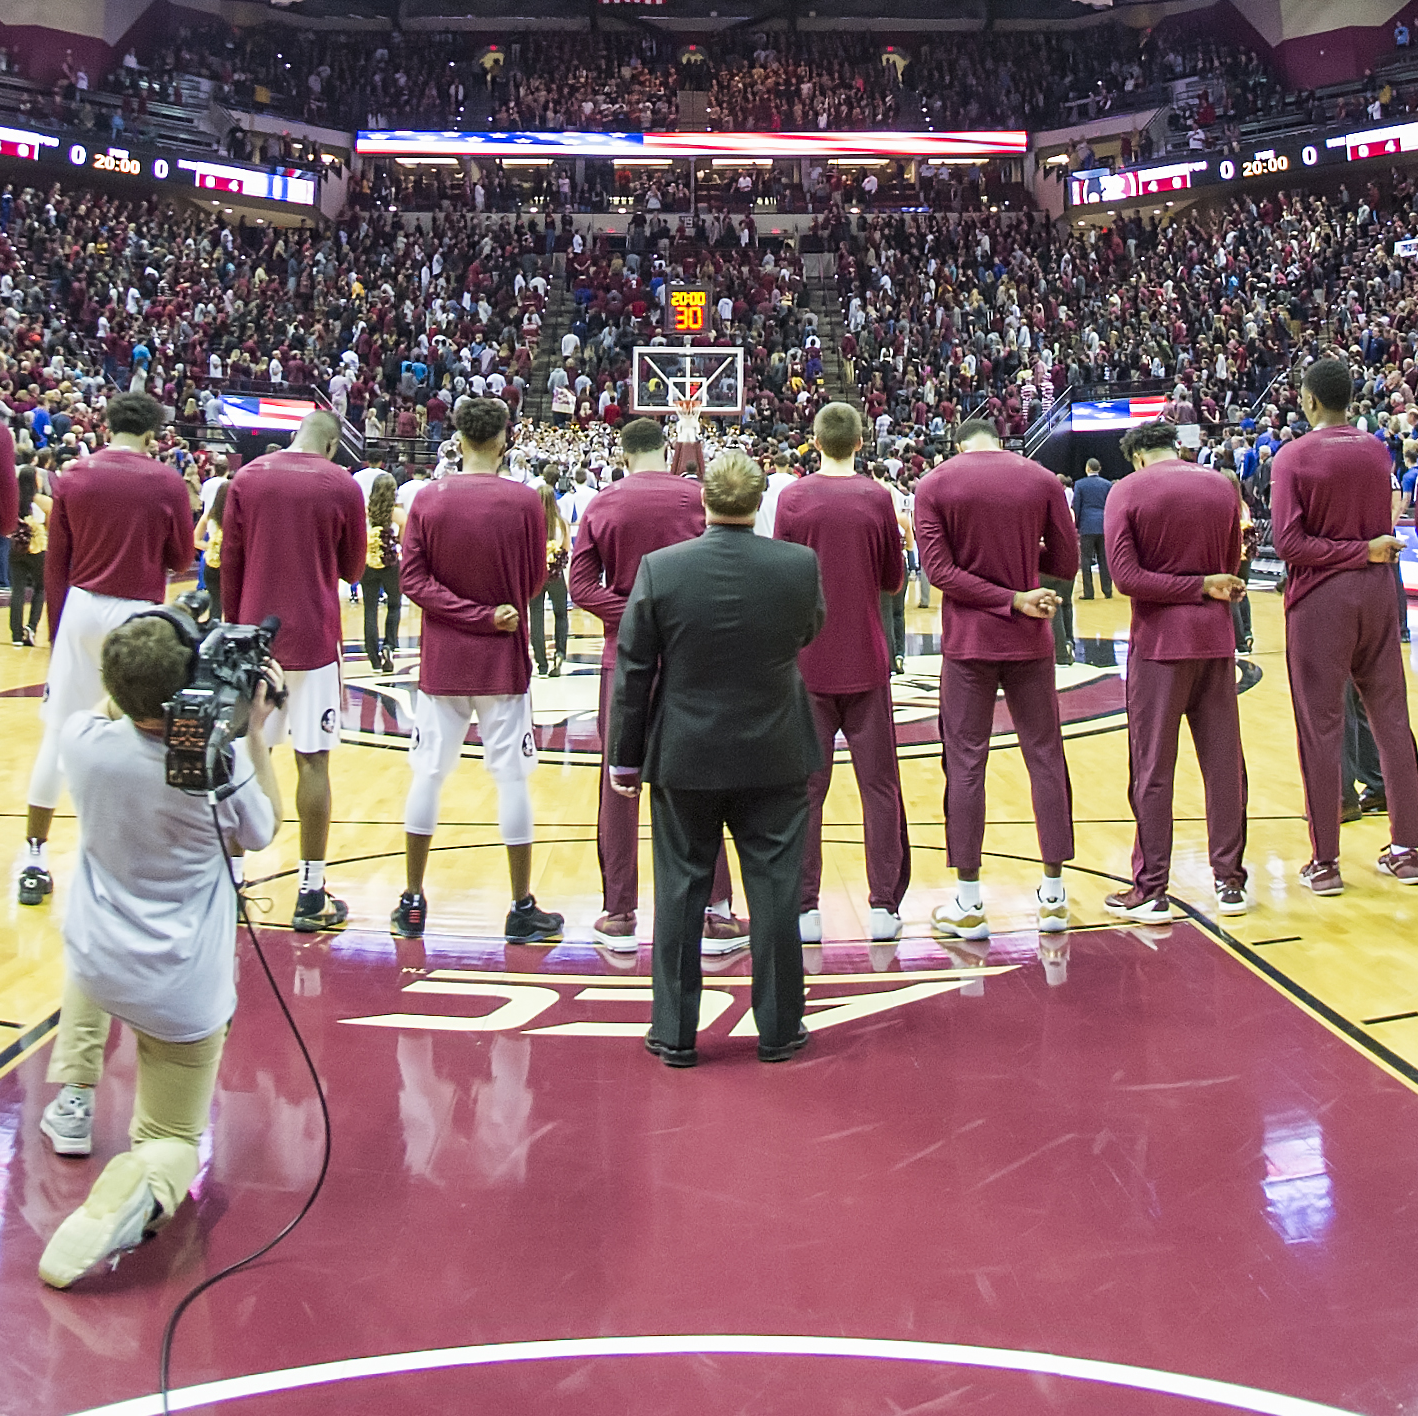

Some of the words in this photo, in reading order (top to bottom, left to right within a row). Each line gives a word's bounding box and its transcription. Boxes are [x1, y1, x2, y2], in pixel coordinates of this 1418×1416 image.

[69, 144, 87, 165] 0
[93, 153, 141, 175] 20:00
[1301, 145, 1317, 166] 0
[153, 159, 169, 179] 0
[1219, 160, 1234, 180] 0
[1242, 155, 1289, 177] 20:00
[671, 291, 706, 306] 20:00
[675, 306, 703, 330] 30
